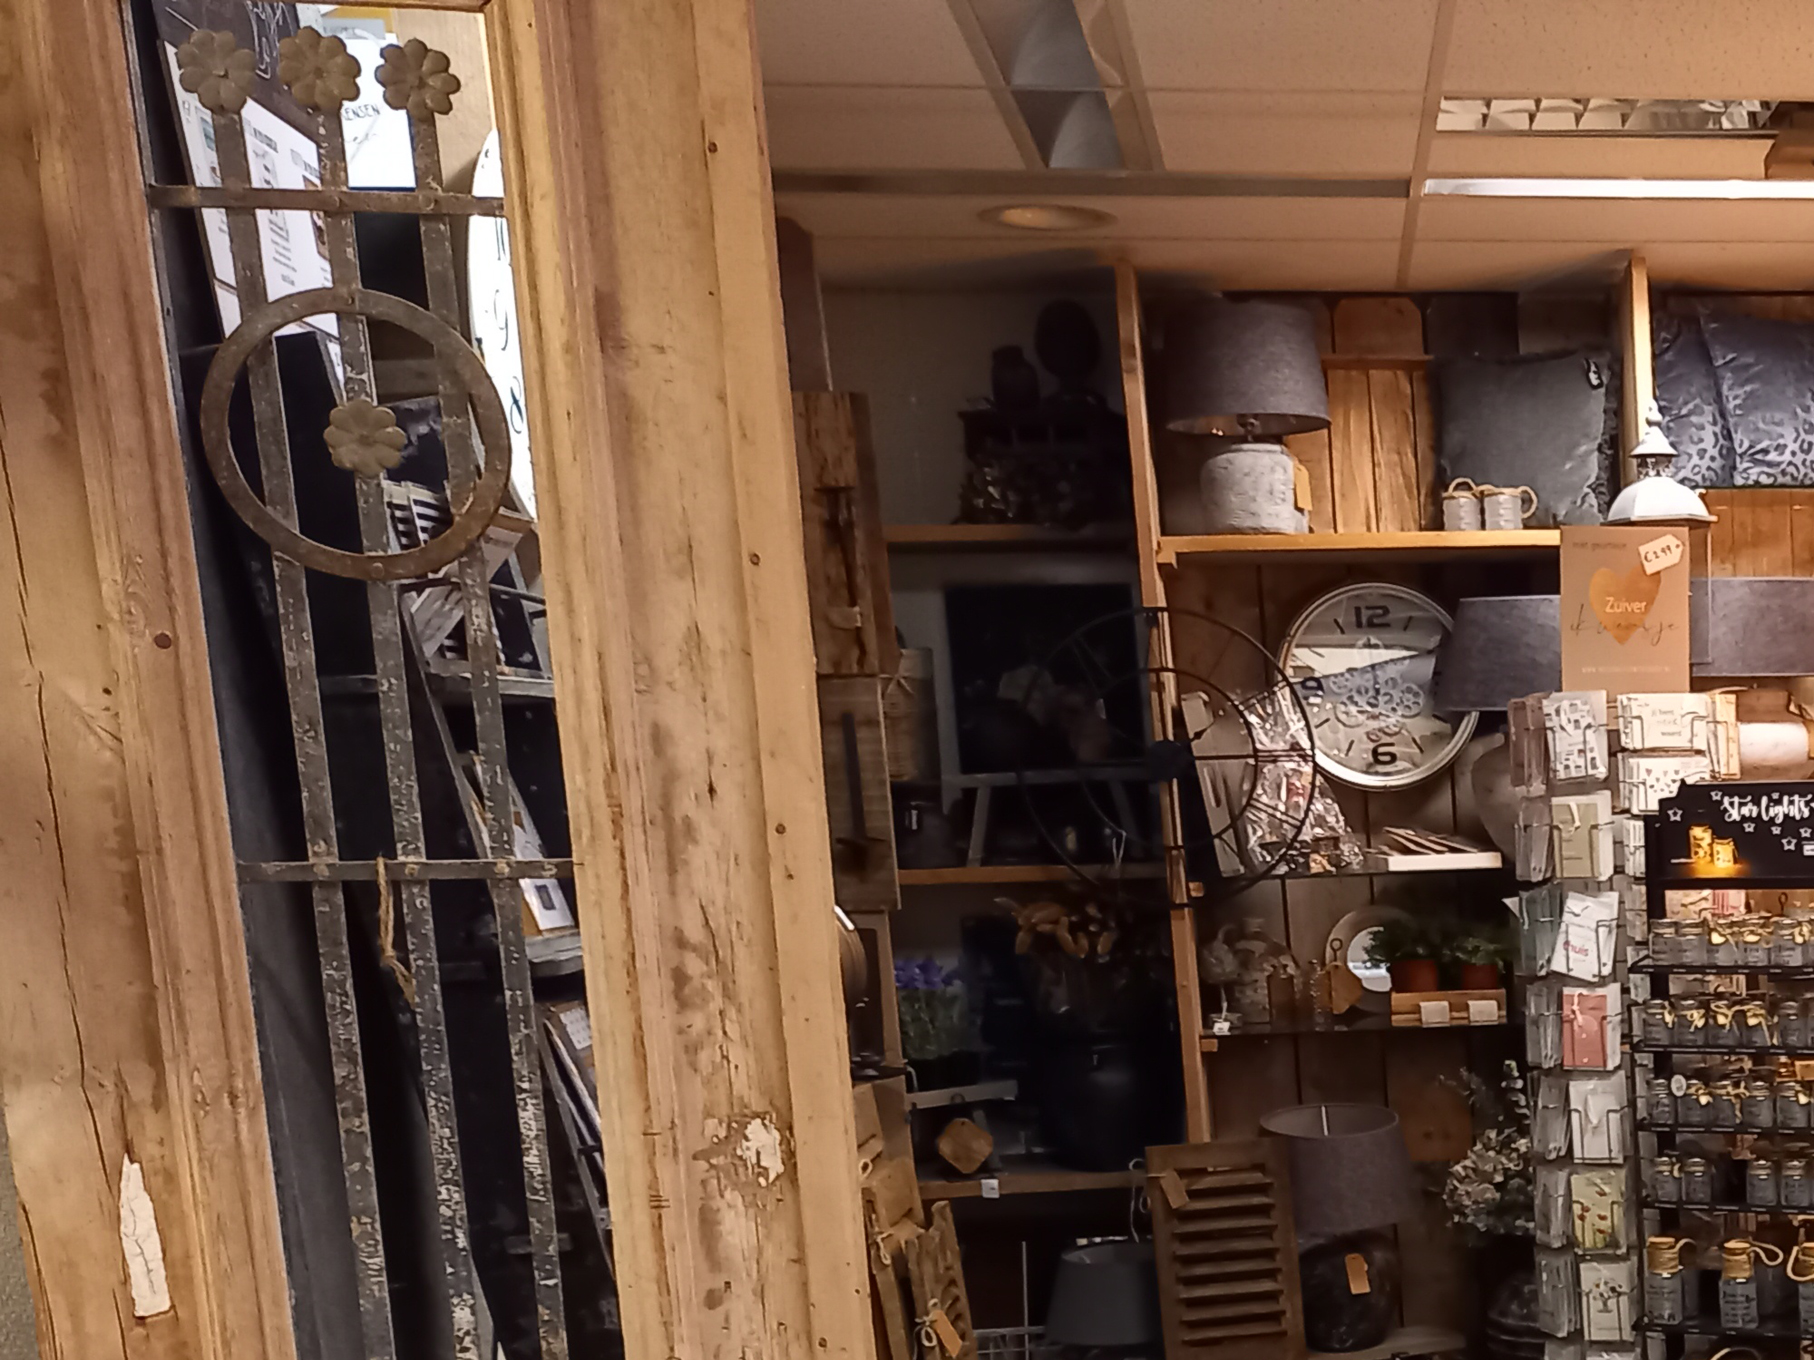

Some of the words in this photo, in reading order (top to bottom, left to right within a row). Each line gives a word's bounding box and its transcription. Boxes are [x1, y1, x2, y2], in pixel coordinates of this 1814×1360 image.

[1604, 596, 1648, 613] Zuiver
[1353, 605, 1391, 629] 12
[1371, 742, 1398, 766] 6
[1720, 794, 1759, 822] Star
[1760, 793, 1813, 824] lights
